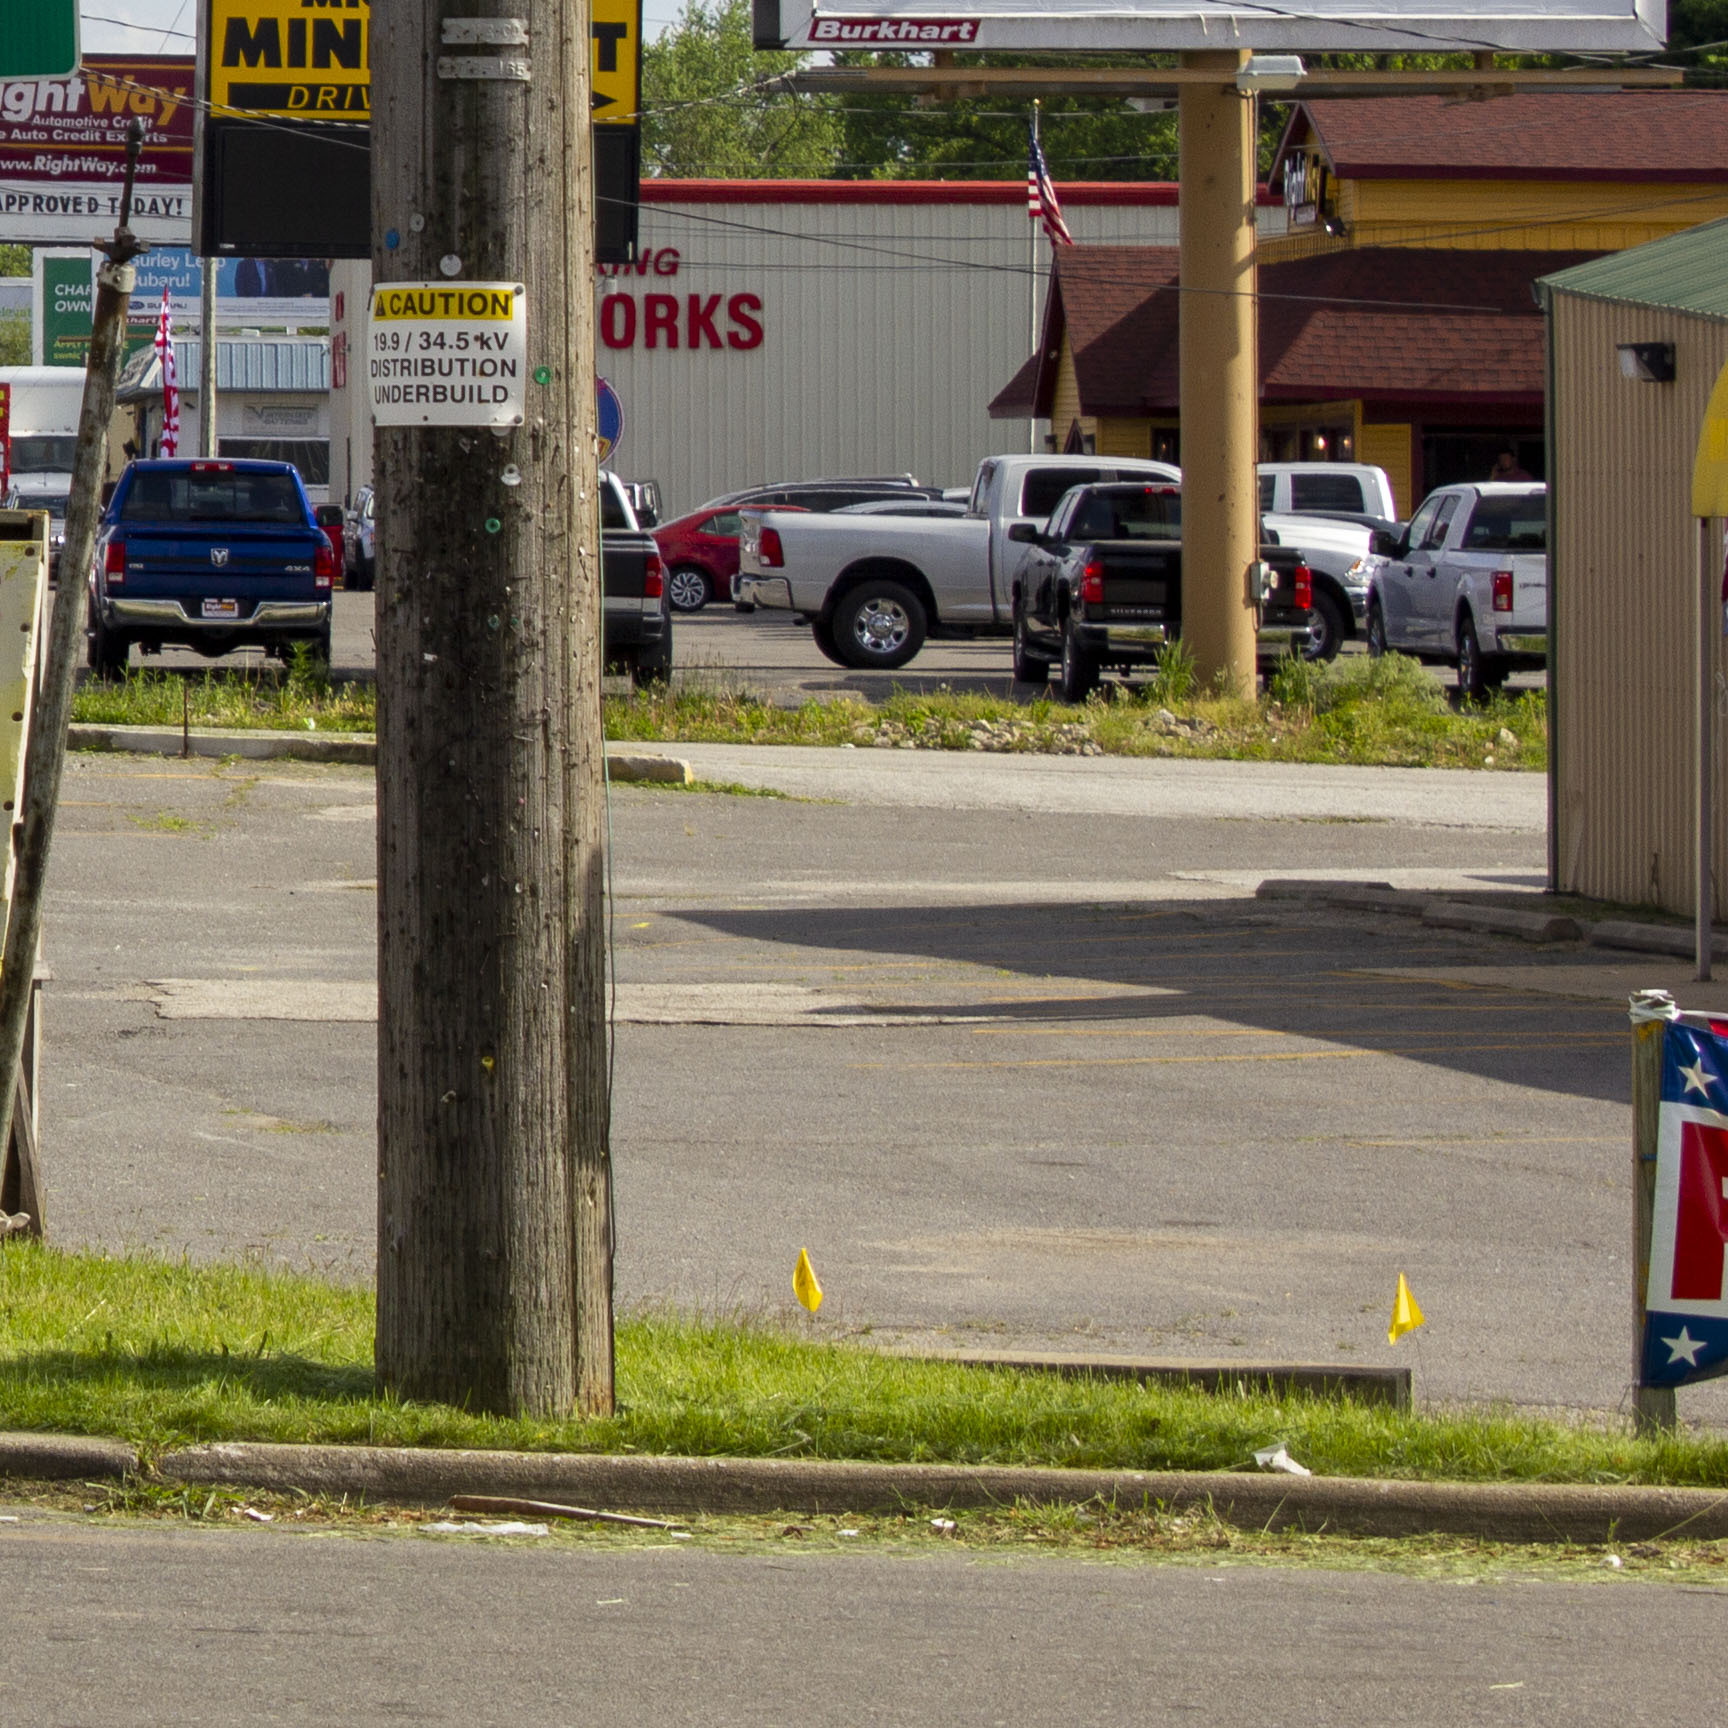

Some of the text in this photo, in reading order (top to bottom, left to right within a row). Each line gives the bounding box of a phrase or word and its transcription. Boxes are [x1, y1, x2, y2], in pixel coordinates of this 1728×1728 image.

[816, 19, 974, 42] Burkhart
[287, 86, 371, 110] DRIV
[32, 115, 108, 129] Automotive
[11, 129, 49, 141] Auto
[52, 129, 103, 143] Credit
[106, 131, 168, 143] Exrts
[108, 197, 183, 216] TDAY!
[134, 273, 191, 288] ubaru!
[389, 292, 510, 316] CAUTION
[600, 292, 764, 351] ORKS
[374, 332, 400, 351] 19.9
[419, 331, 470, 350] 34.5
[479, 332, 509, 350] kV
[371, 358, 517, 378] DISTRIBUTION
[374, 384, 509, 404] UNDERBUILD
